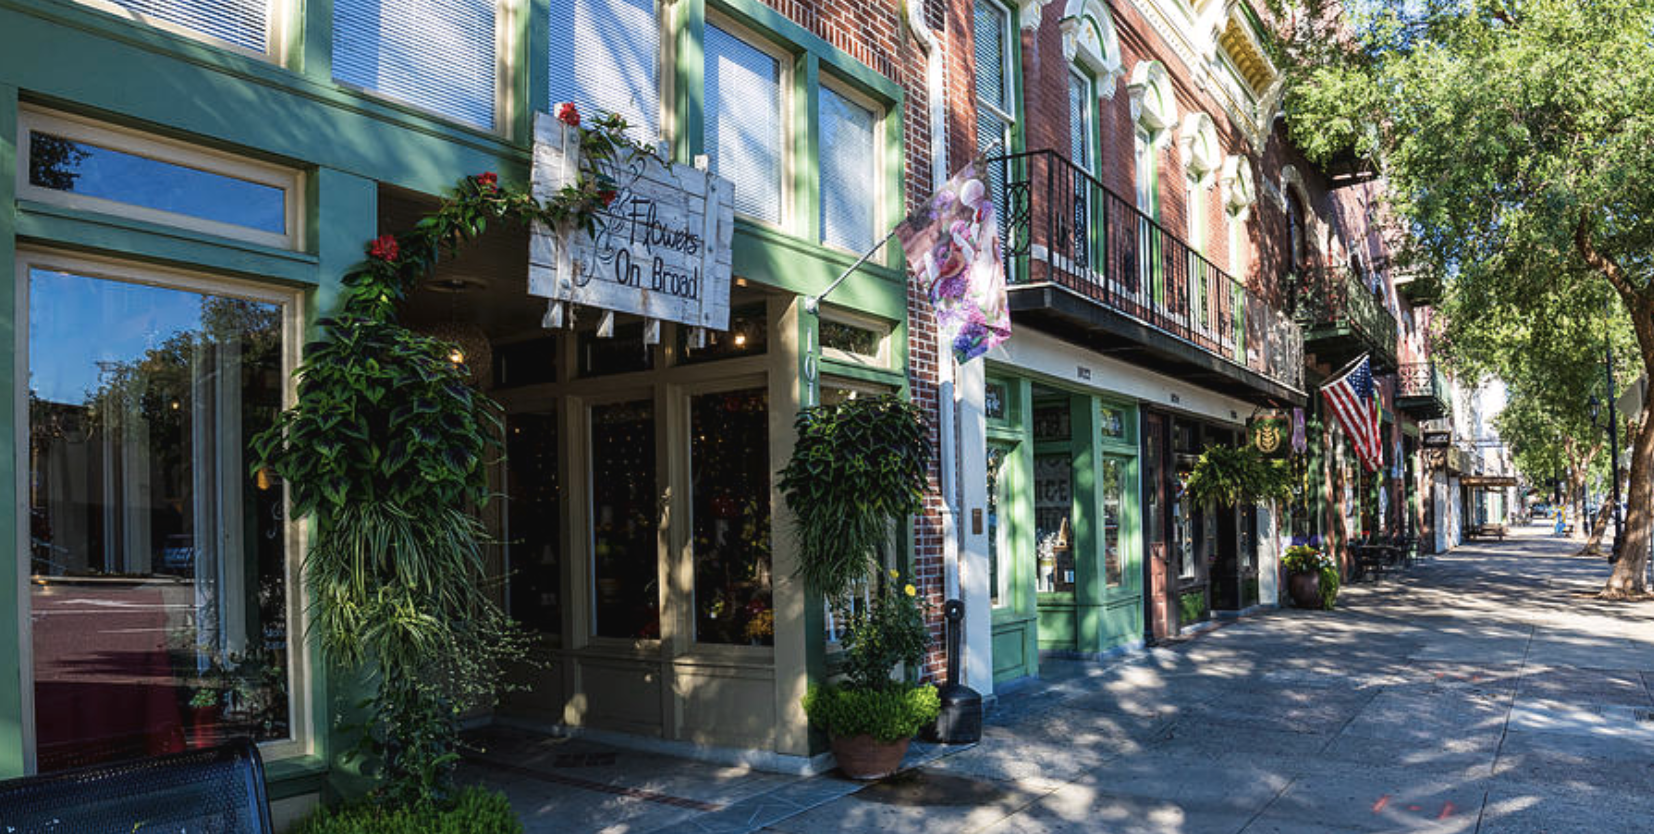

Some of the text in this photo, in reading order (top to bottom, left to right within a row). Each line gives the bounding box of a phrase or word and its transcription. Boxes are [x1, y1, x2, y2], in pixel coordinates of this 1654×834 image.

[627, 198, 699, 255] Flowers
[615, 248, 698, 299] On Broad
